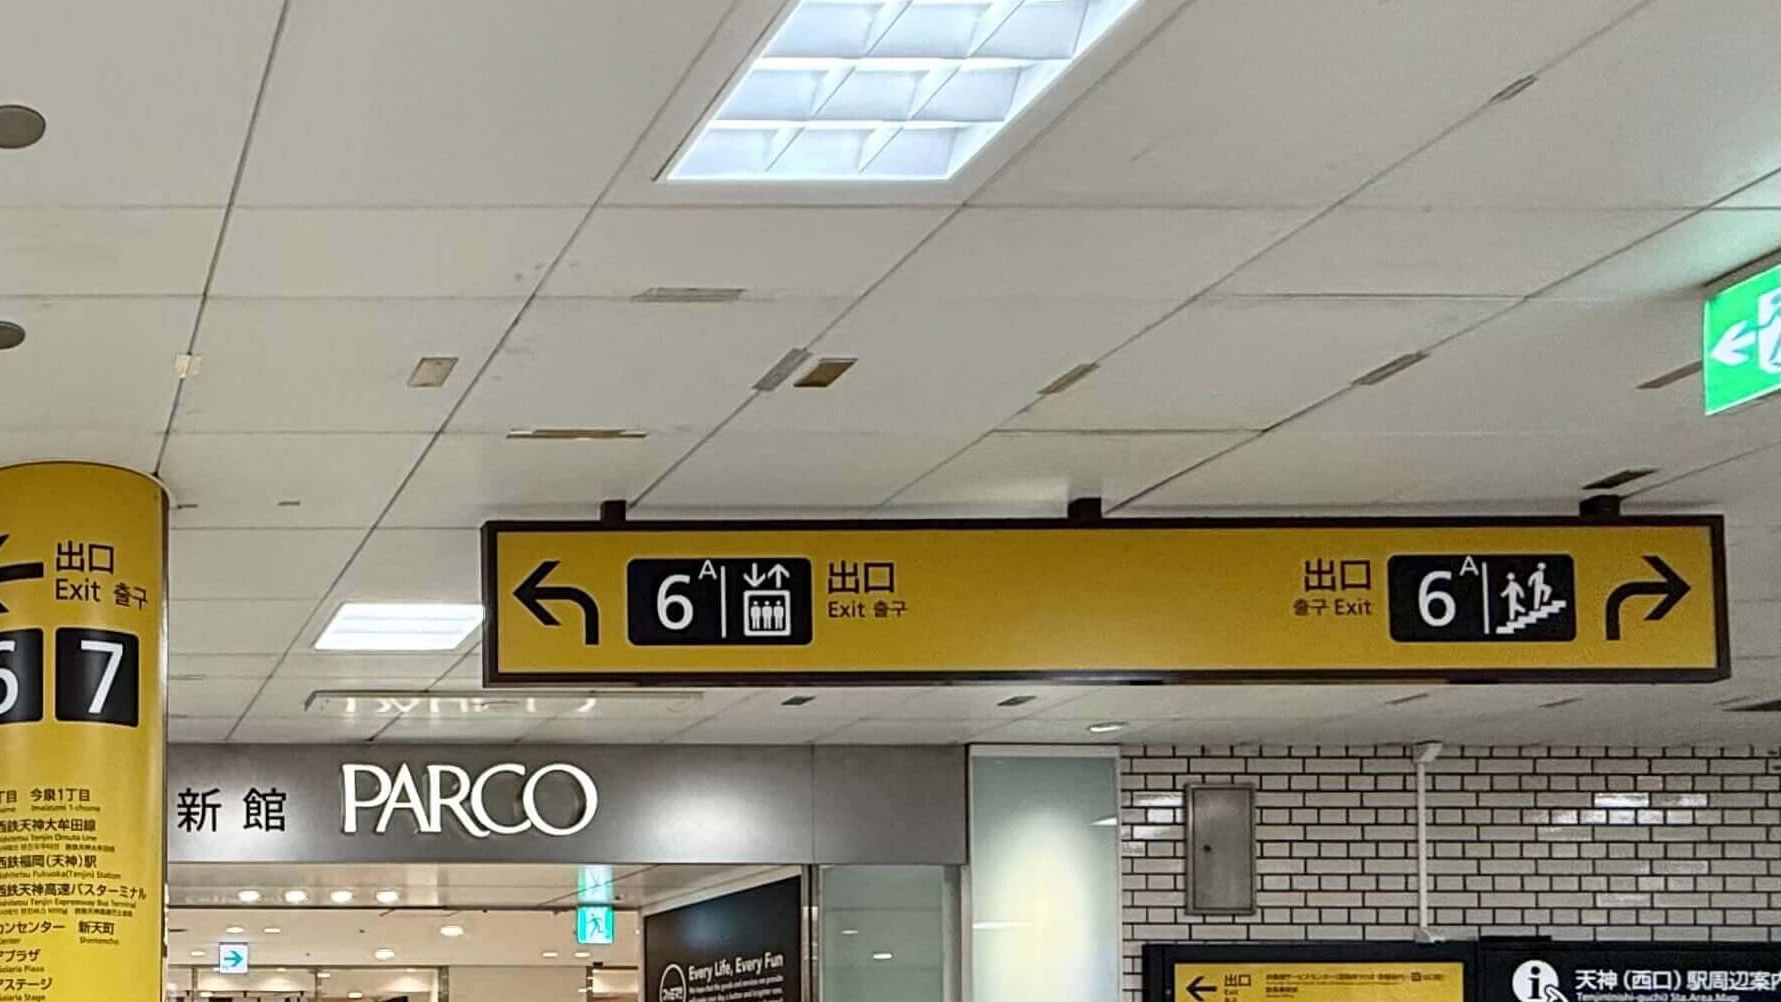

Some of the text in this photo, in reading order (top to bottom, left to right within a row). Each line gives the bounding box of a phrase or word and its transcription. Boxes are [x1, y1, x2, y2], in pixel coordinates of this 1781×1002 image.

[55, 540, 115, 575] 出口
[826, 561, 896, 595] 出口
[1303, 558, 1372, 593] 出口
[55, 578, 101, 603] Exit
[113, 582, 149, 611] 출구
[827, 600, 866, 619] Exit
[872, 600, 908, 619] 출구
[1292, 598, 1329, 617] 출구
[1334, 598, 1372, 616] Exit
[80, 639, 125, 715] 7
[29, 787, 91, 803] 今泉1丁目
[341, 762, 599, 837] PARCO
[176, 787, 288, 833] 新館
[78, 921, 115, 936] 新天町
[688, 951, 785, 983] Every Life, Every Fun
[1224, 973, 1252, 987] 出口
[24, 994, 46, 1002] Stage
